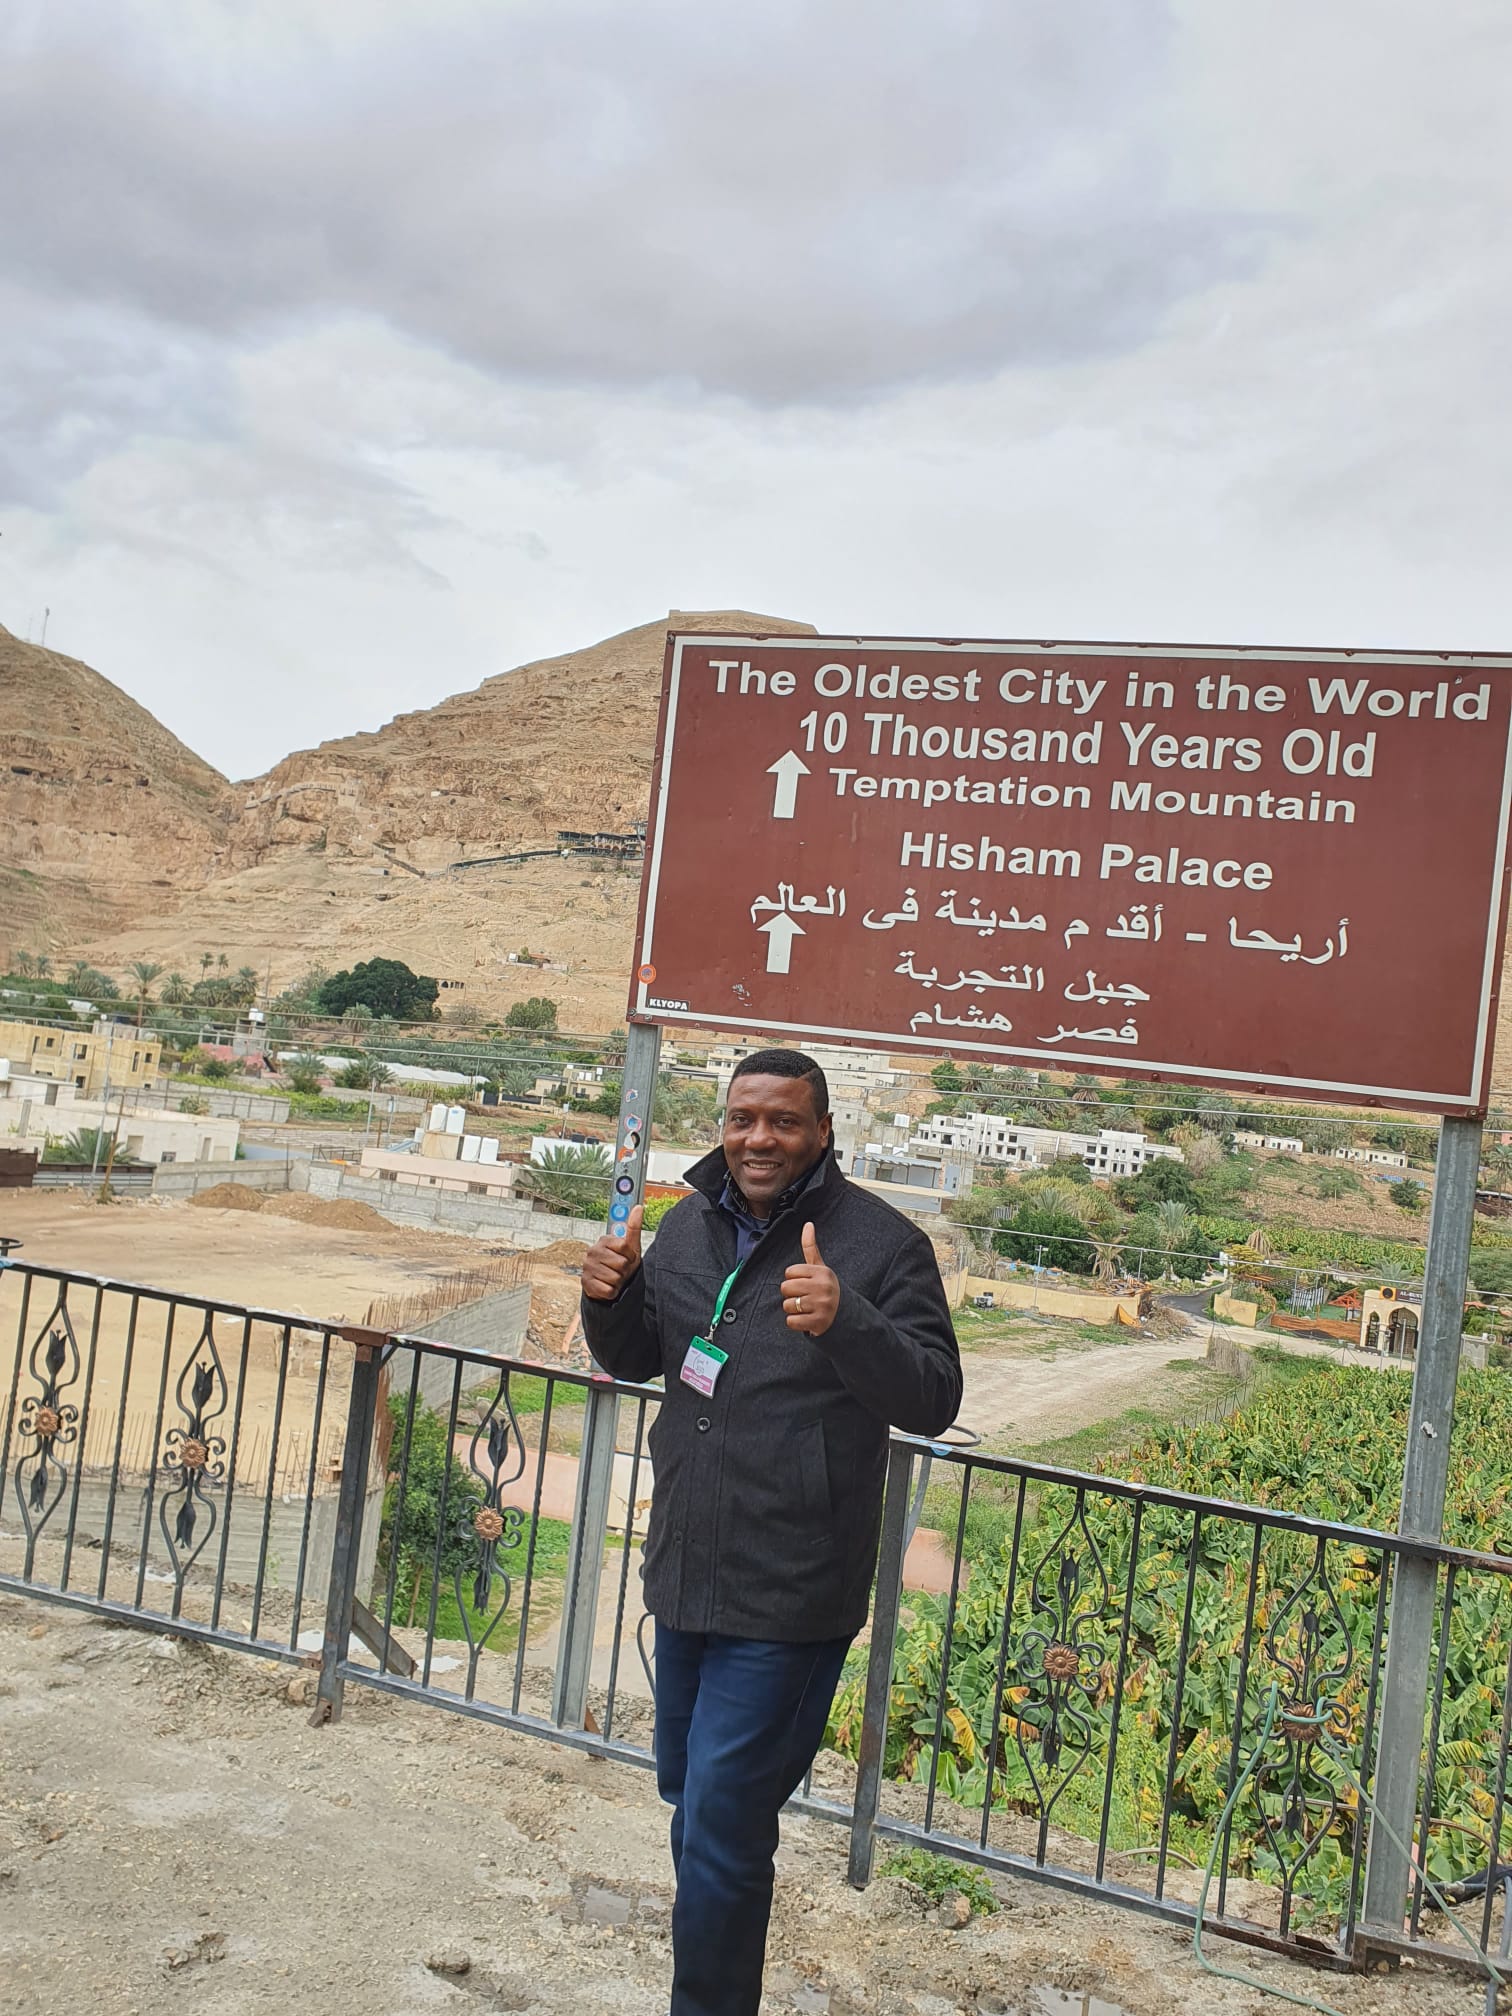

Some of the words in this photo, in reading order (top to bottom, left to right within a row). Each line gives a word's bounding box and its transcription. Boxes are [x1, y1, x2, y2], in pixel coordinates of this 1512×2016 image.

[708, 660, 797, 696] The
[814, 663, 982, 704] Oldest
[999, 668, 1108, 715] City
[1125, 671, 1174, 708] in
[1195, 674, 1286, 712] the
[1308, 677, 1491, 721] World
[800, 710, 848, 754] 10
[863, 712, 1103, 764] Thousand
[1119, 721, 1262, 772] Years
[1282, 728, 1377, 778] Old
[828, 767, 1091, 809] Temptation
[1110, 780, 1356, 823] Mountain
[900, 831, 1081, 878] Hisham
[1099, 843, 1273, 891] Palace
[750, 881, 846, 924] العالم
[934, 889, 1047, 937] مدينة
[1228, 916, 1349, 965] أريحا
[894, 950, 1045, 994] التجربة
[1063, 969, 1151, 1007] جبل
[649, 998, 688, 1011] KLYOPA
[909, 1003, 1013, 1033] هشام
